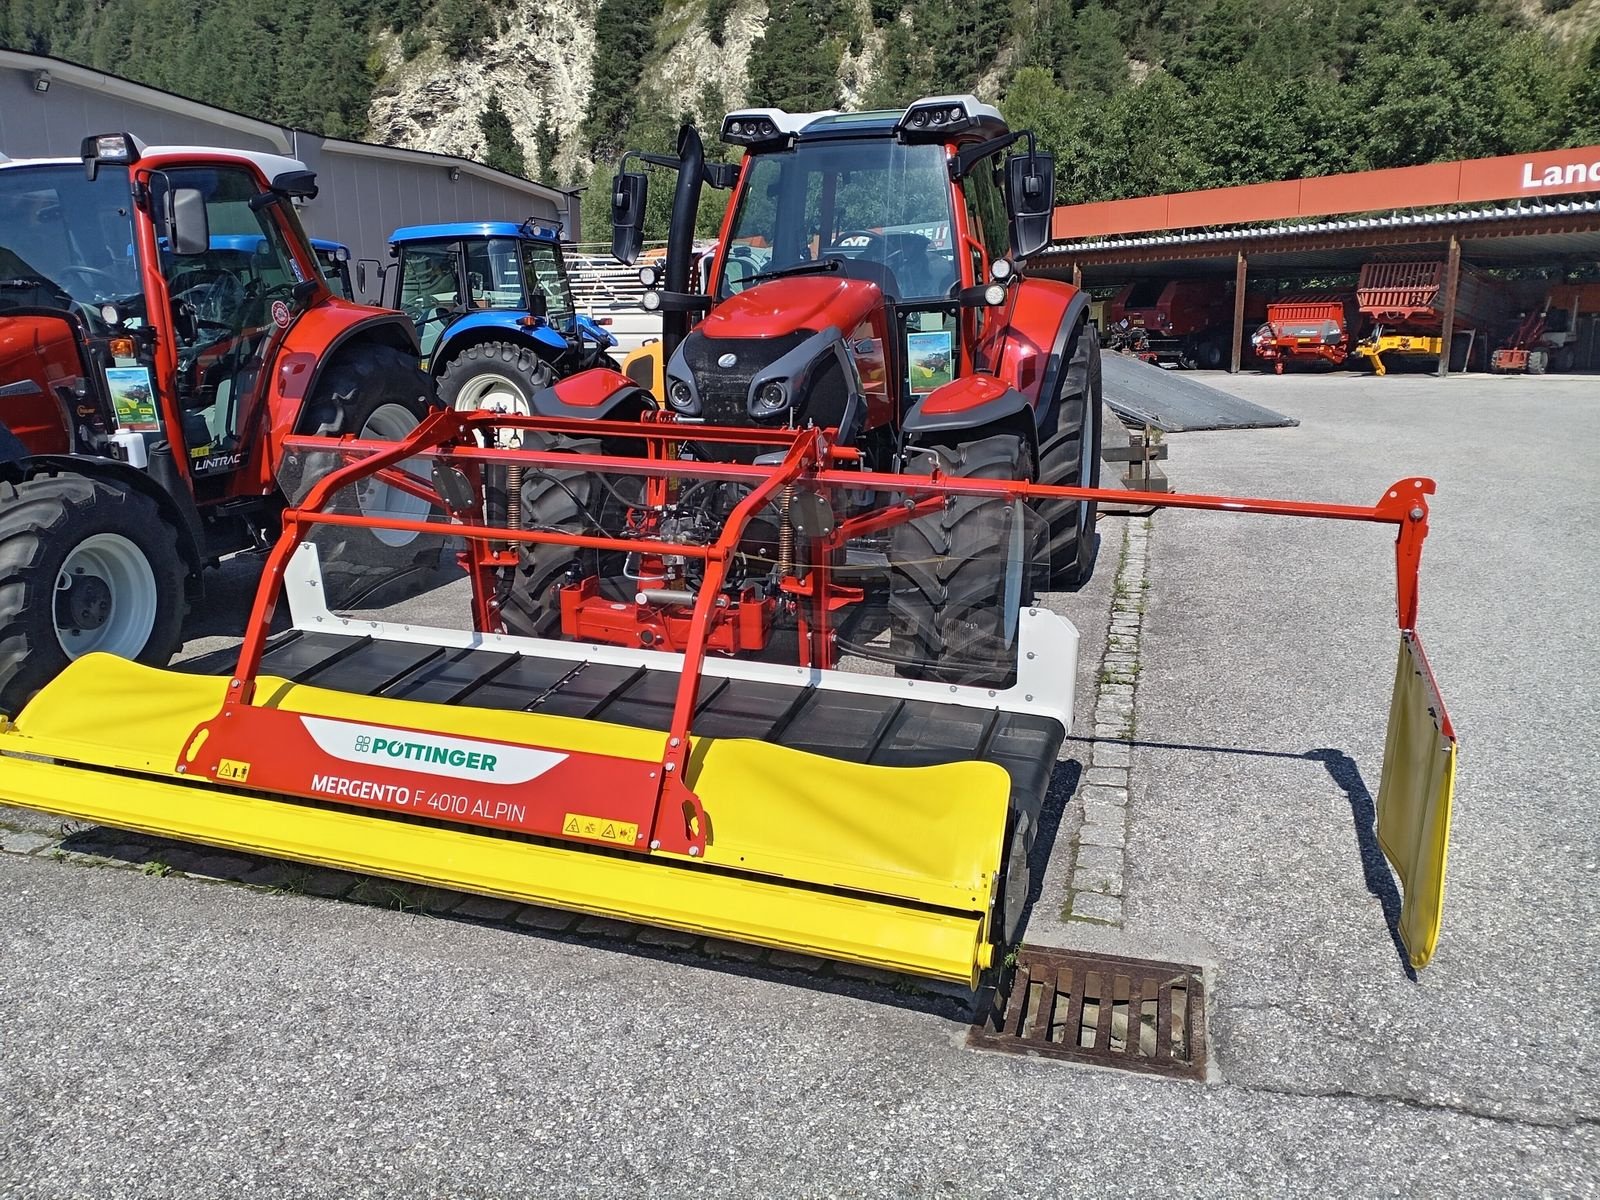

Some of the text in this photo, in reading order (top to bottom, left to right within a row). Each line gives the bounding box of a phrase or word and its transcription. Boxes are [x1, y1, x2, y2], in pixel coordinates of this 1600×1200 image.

[195, 453, 241, 471] LINTRAC
[311, 775, 527, 824] MERGENTO F 4010 ALPIN
